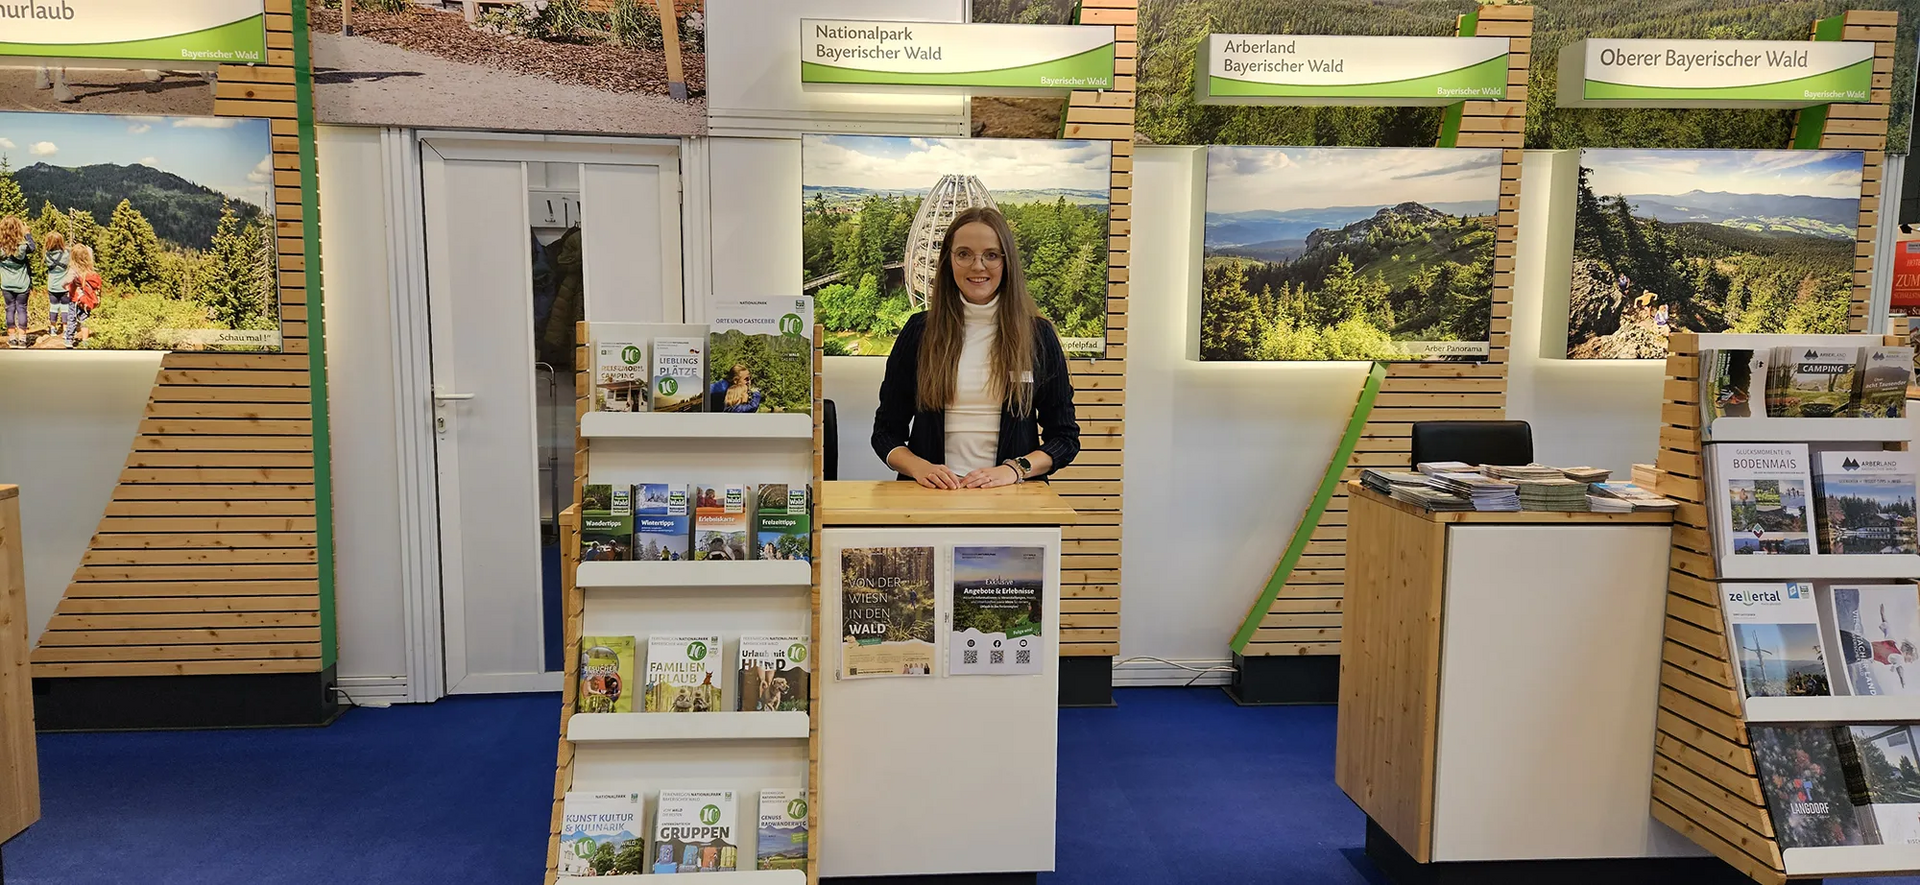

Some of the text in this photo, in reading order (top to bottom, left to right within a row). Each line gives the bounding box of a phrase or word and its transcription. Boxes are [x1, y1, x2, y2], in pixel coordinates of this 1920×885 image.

[816, 25, 913, 42] Nationalpark
[816, 44, 942, 61] Bayerischer Wald
[1224, 40, 1295, 54] Arberland
[182, 48, 258, 60] Bayerischer Wald
[1600, 49, 1808, 71] Oberer Bayerischer Wald
[1224, 59, 1343, 76] Bayerischer Wald
[1040, 76, 1107, 86] Bayerischer Wald
[1437, 87, 1501, 96] Bayerischer Wald
[1804, 90, 1865, 100] Bayerischer Wald
[660, 365, 697, 375] PLÄTZE
[1733, 459, 1796, 468] BODENMAIS
[849, 577, 901, 588] VON DER
[848, 593, 888, 604] WIESN
[1729, 591, 1781, 601] zellertal
[849, 608, 890, 619] IN DEN
[849, 623, 886, 635] WALD
[650, 663, 705, 672] FAMILIEN
[650, 674, 697, 683] URLAUB
[1865, 671, 1877, 696] LAND
[1790, 802, 1829, 814] LANGDORF
[566, 814, 633, 822] KUNST KULTUR
[565, 823, 625, 832] & KULINARIK
[660, 827, 730, 839] GRUPPEN
